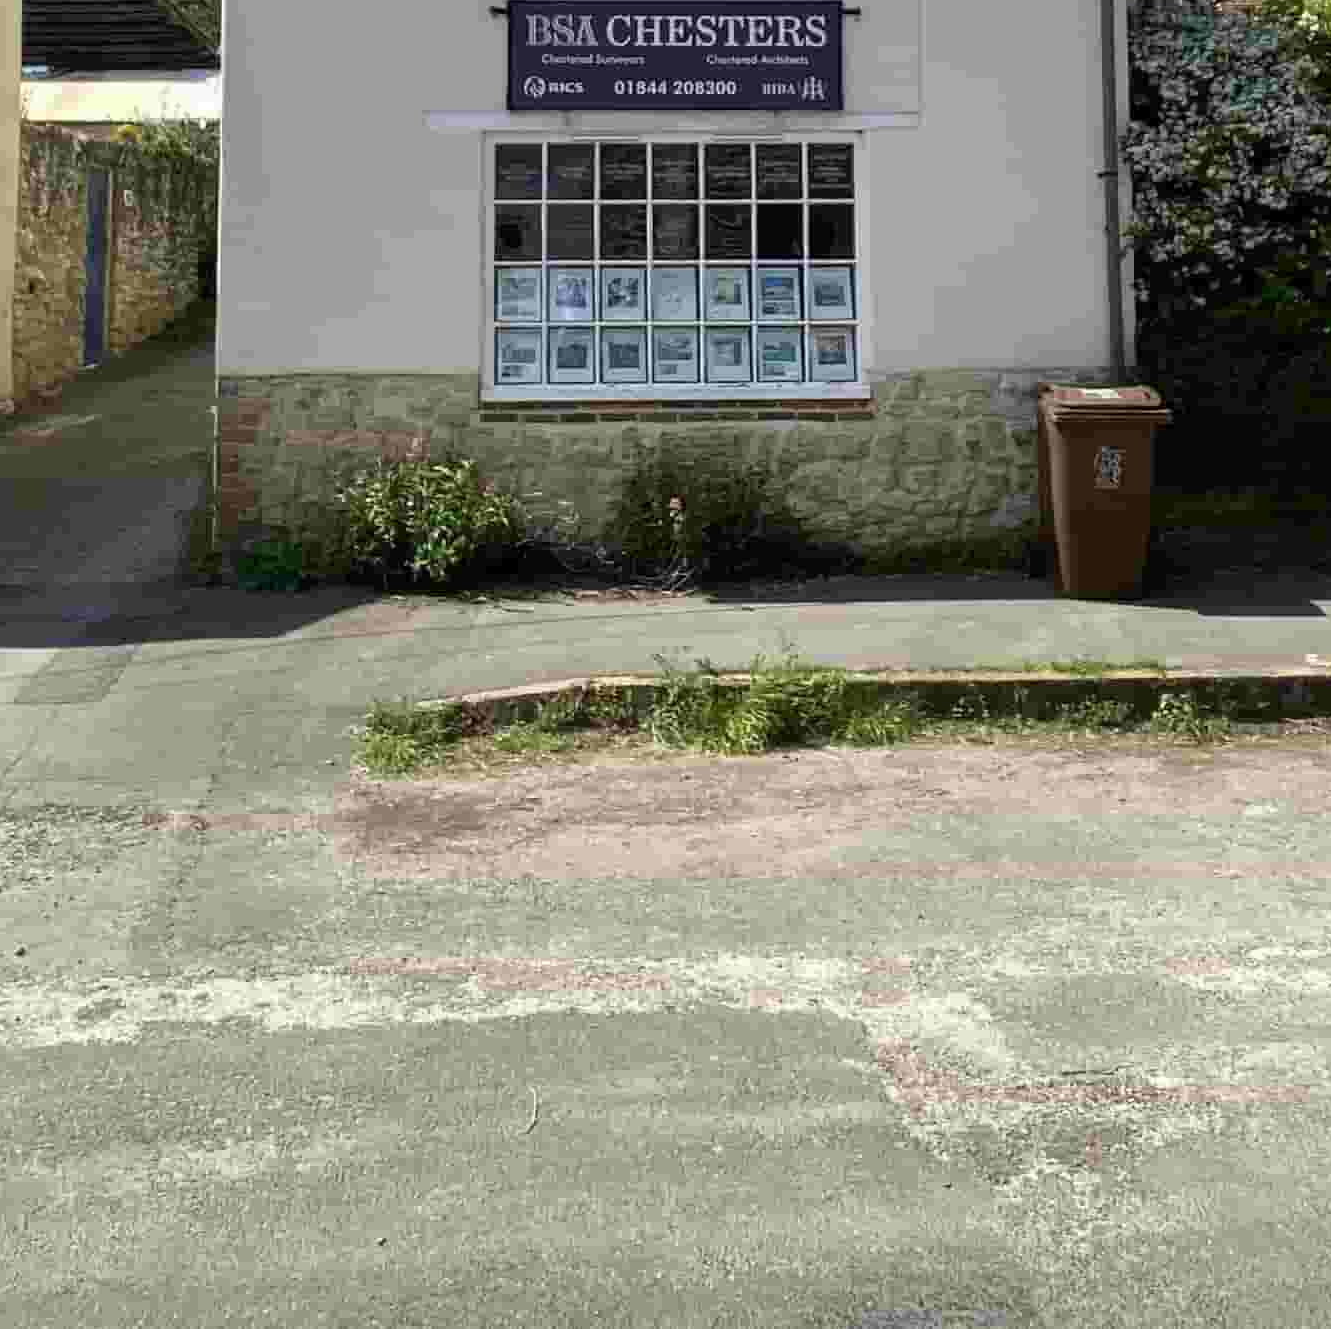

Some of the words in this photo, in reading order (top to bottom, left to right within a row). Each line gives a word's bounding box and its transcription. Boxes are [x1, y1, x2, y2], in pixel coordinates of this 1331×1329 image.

[525, 13, 599, 47] BSA
[605, 13, 827, 47] CHESTERS
[613, 79, 668, 95] 01844
